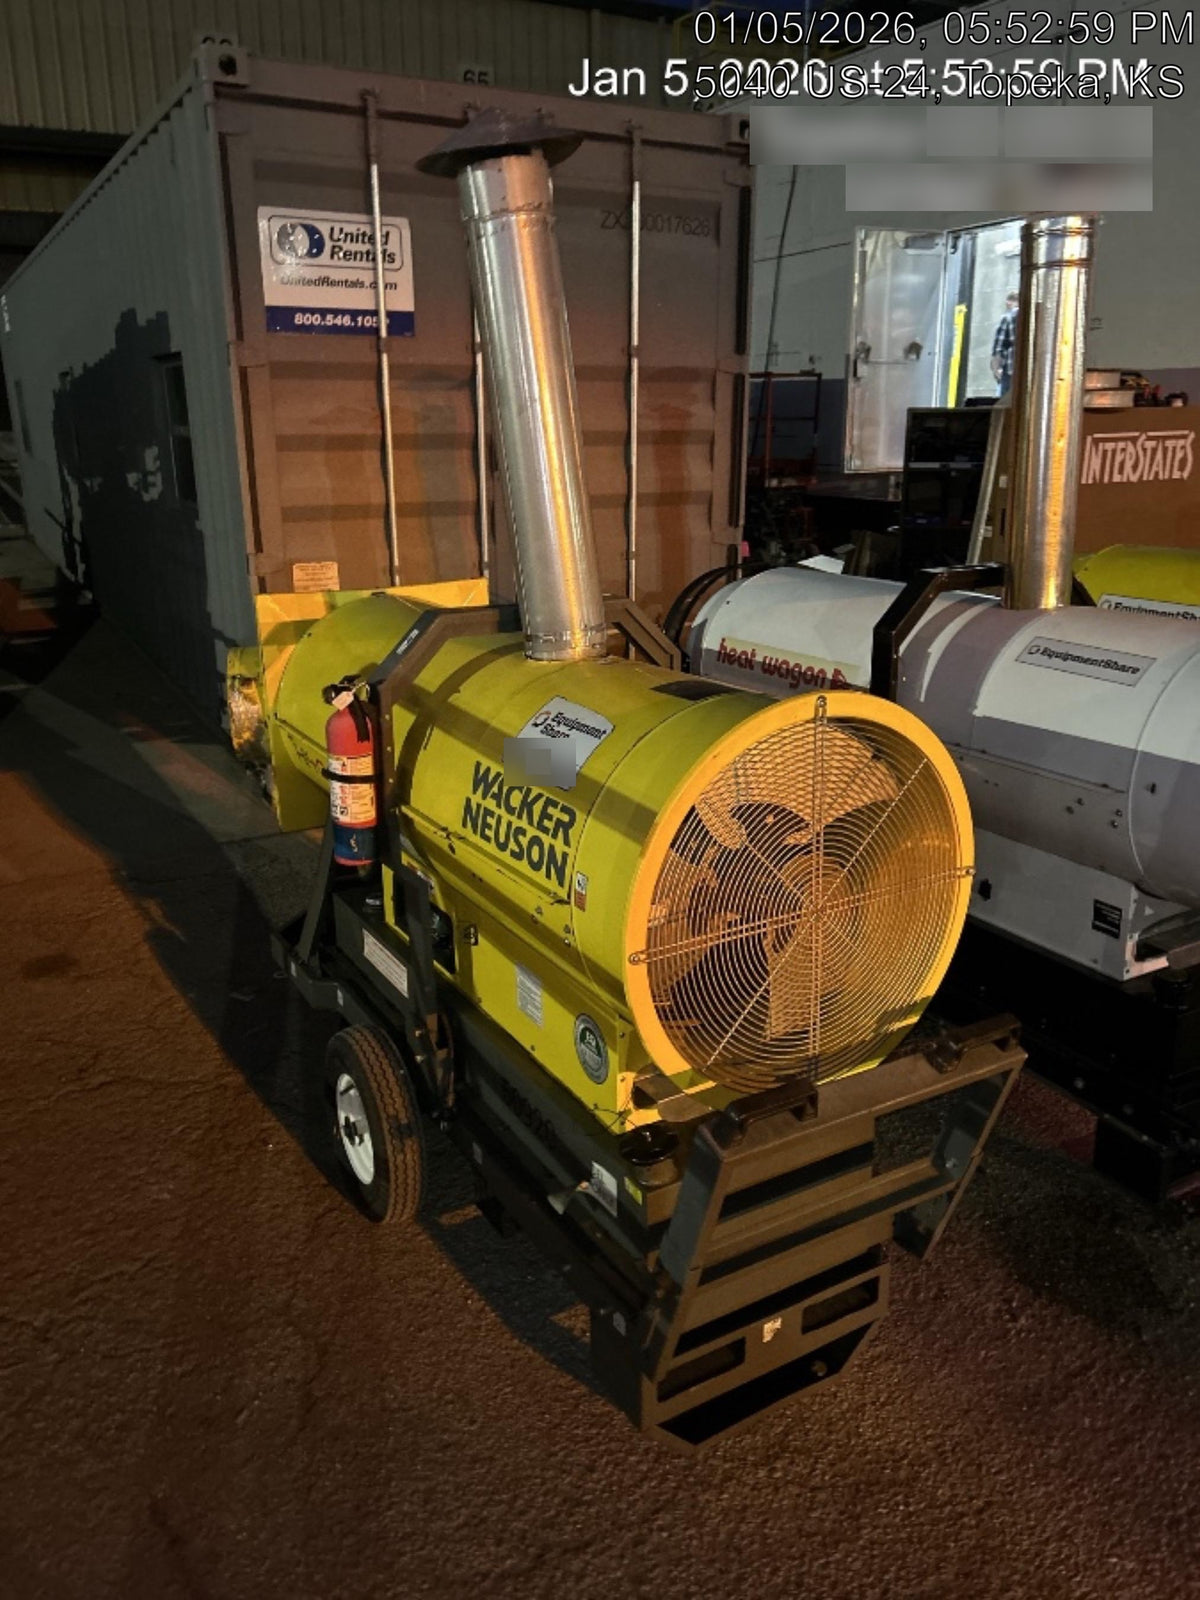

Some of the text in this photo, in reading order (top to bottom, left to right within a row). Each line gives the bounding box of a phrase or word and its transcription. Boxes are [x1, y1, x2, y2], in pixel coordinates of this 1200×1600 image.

[294, 312, 390, 328] 800.546.105
[716, 637, 828, 689] heat wagon
[1040, 646, 1142, 675] EquipmentShare
[551, 711, 607, 740] Equipment
[472, 760, 577, 849] WACKER
[462, 796, 570, 889] NEUSON
